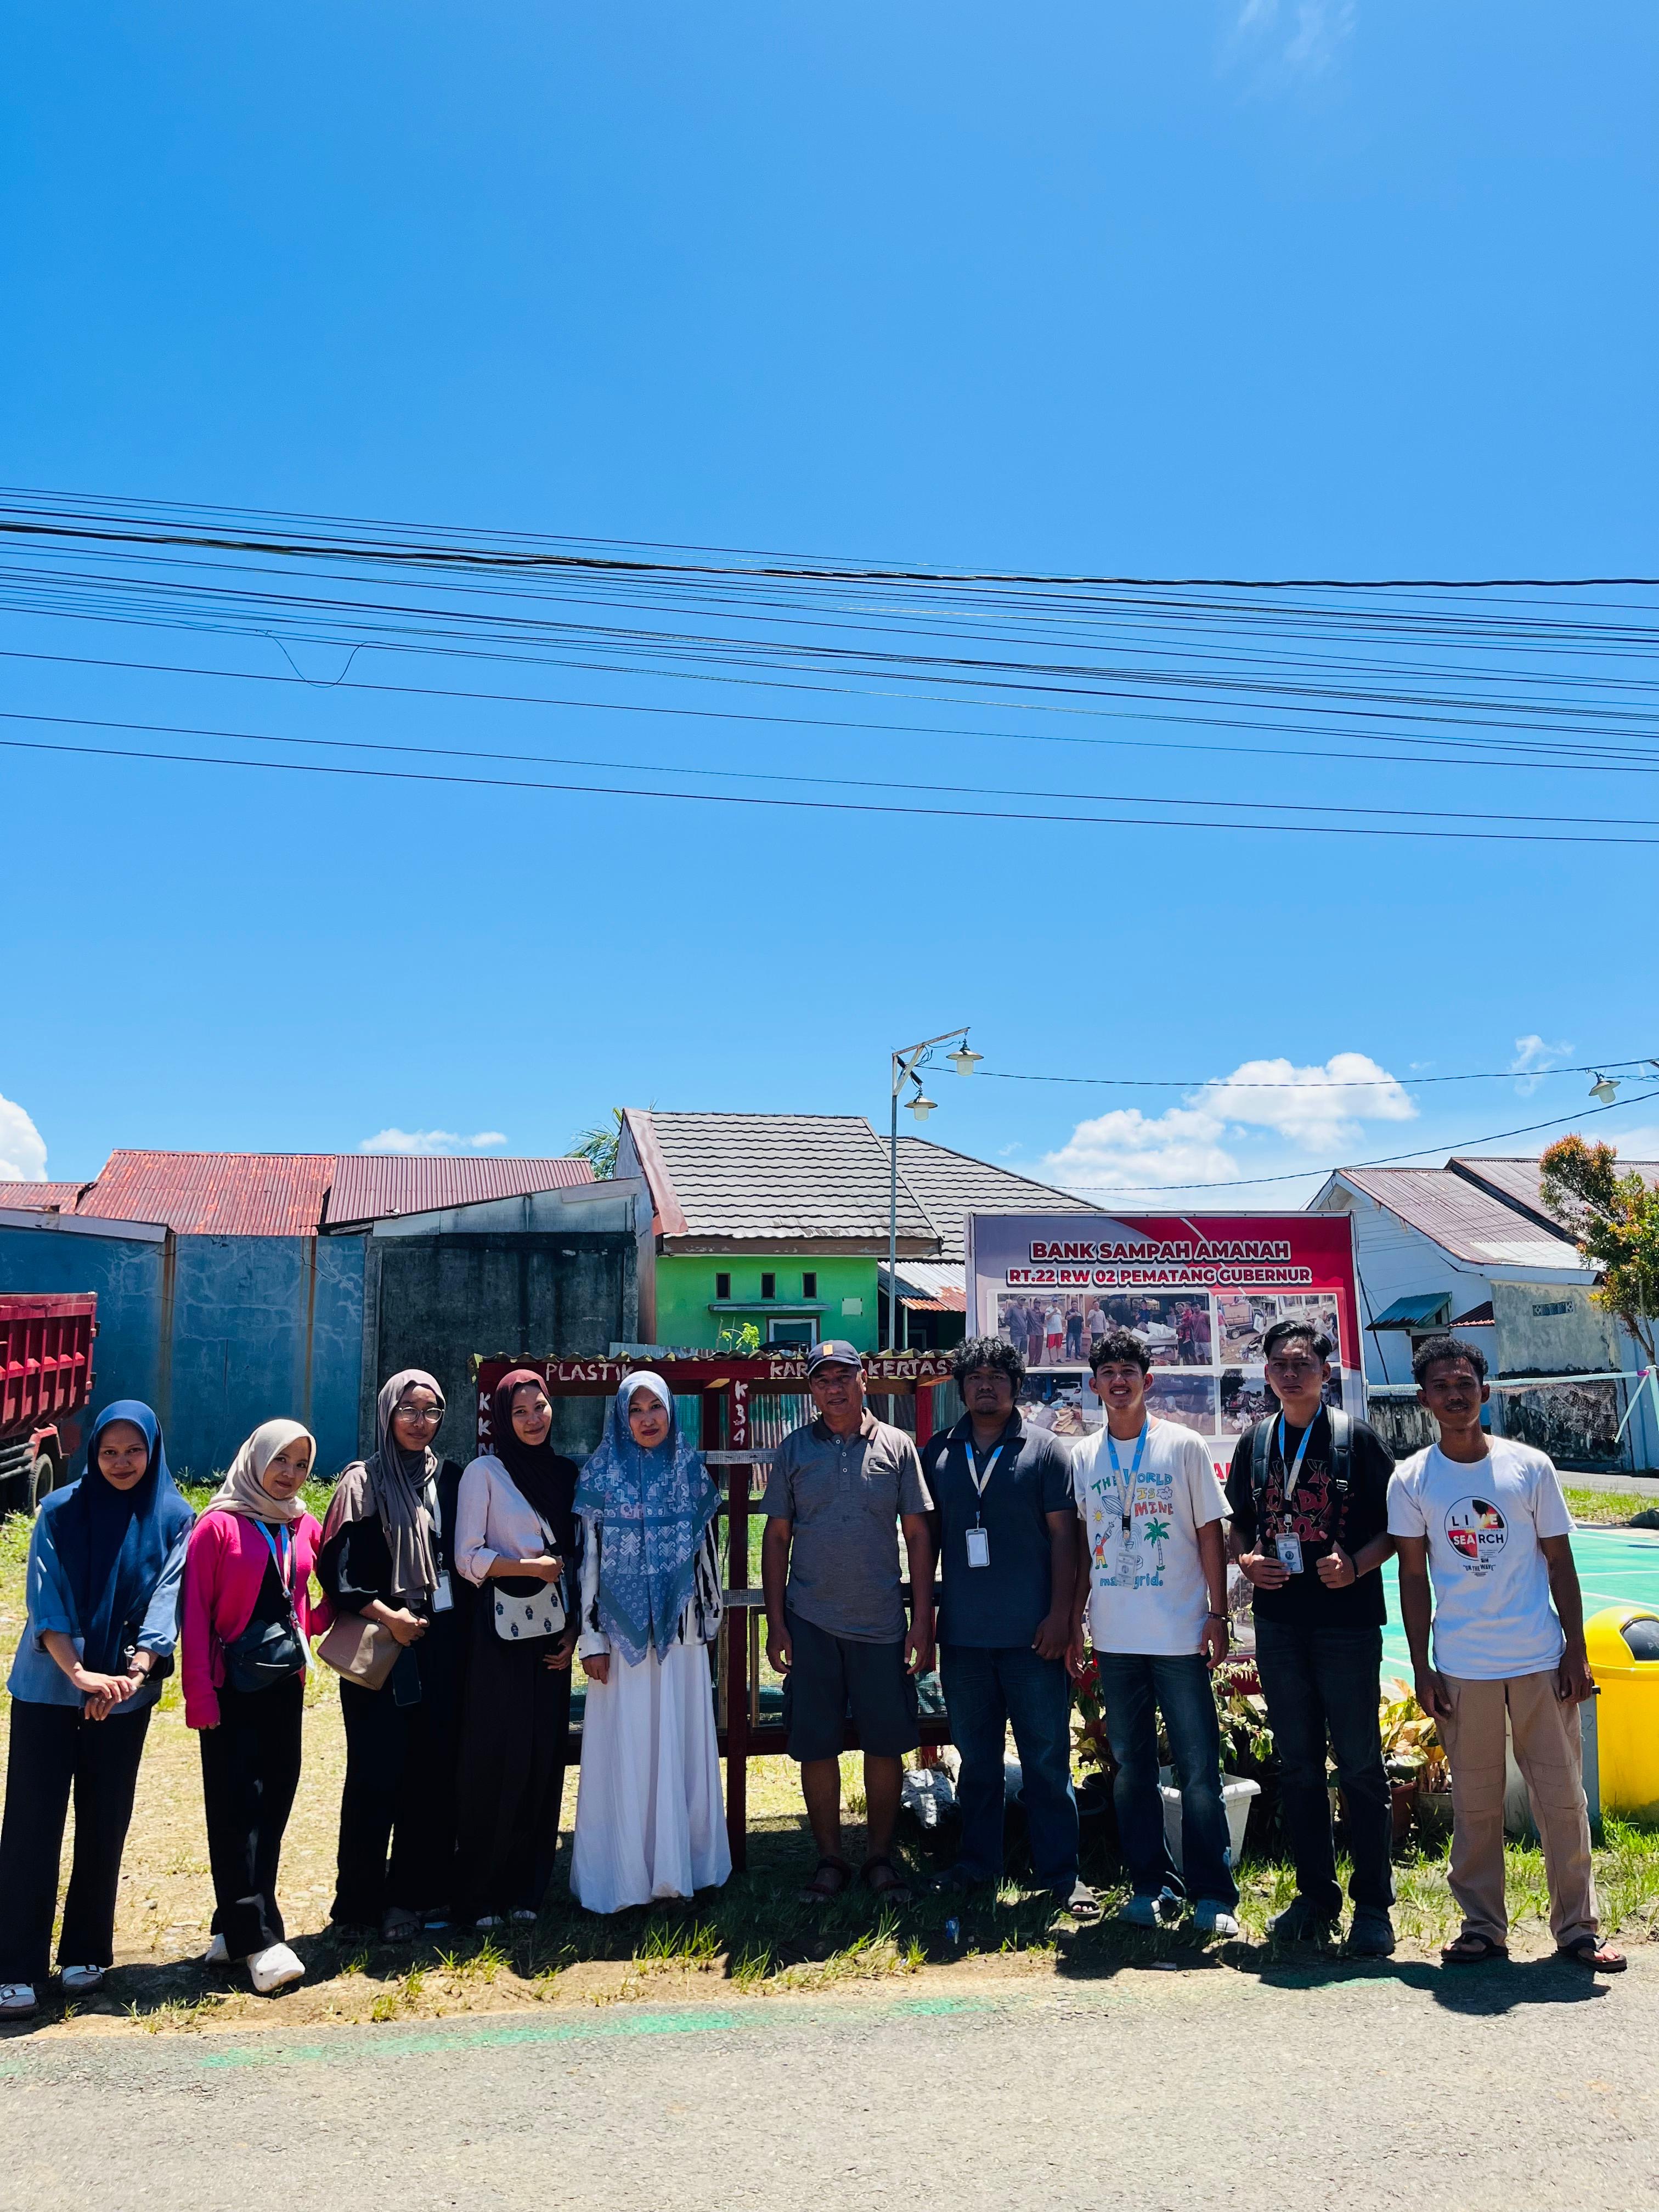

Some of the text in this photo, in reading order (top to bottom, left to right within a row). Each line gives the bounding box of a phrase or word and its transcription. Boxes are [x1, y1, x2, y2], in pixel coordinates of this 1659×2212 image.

[1032, 1242, 1289, 1260] BANK SAMPAH AMANAH
[1009, 1268, 1312, 1283] RT.22 RW 02 PEMATANG GUBERNUR
[546, 1363, 635, 1381] PLASTIK
[868, 1359, 948, 1376] KERTAS
[1090, 1475, 1117, 1496] THE
[1136, 1487, 1155, 1500] IS
[1134, 1500, 1174, 1517] MINE
[1453, 1533, 1504, 1545] SEARCH
